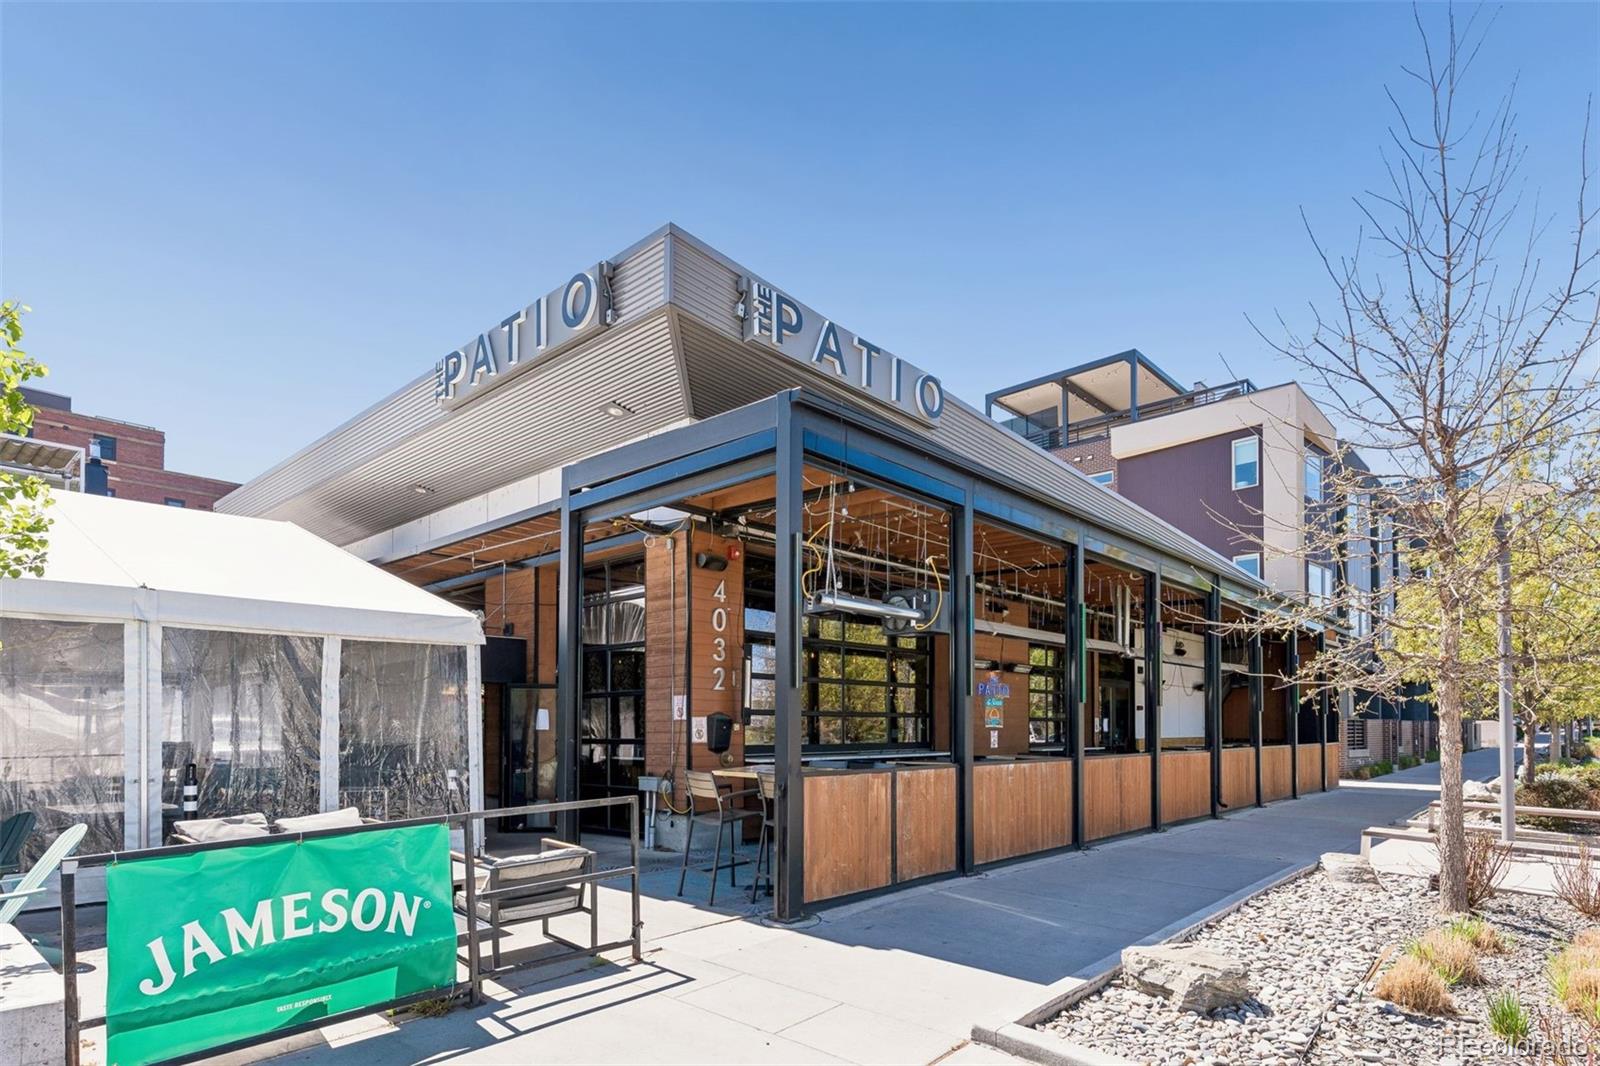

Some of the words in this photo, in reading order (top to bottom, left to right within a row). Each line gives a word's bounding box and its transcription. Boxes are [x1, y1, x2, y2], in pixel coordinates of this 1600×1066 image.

[445, 272, 598, 400] PATIO
[753, 282, 772, 336] THE
[771, 292, 944, 419] PATIO
[712, 579, 727, 691] 4032
[276, 1003, 294, 1012] TASTE
